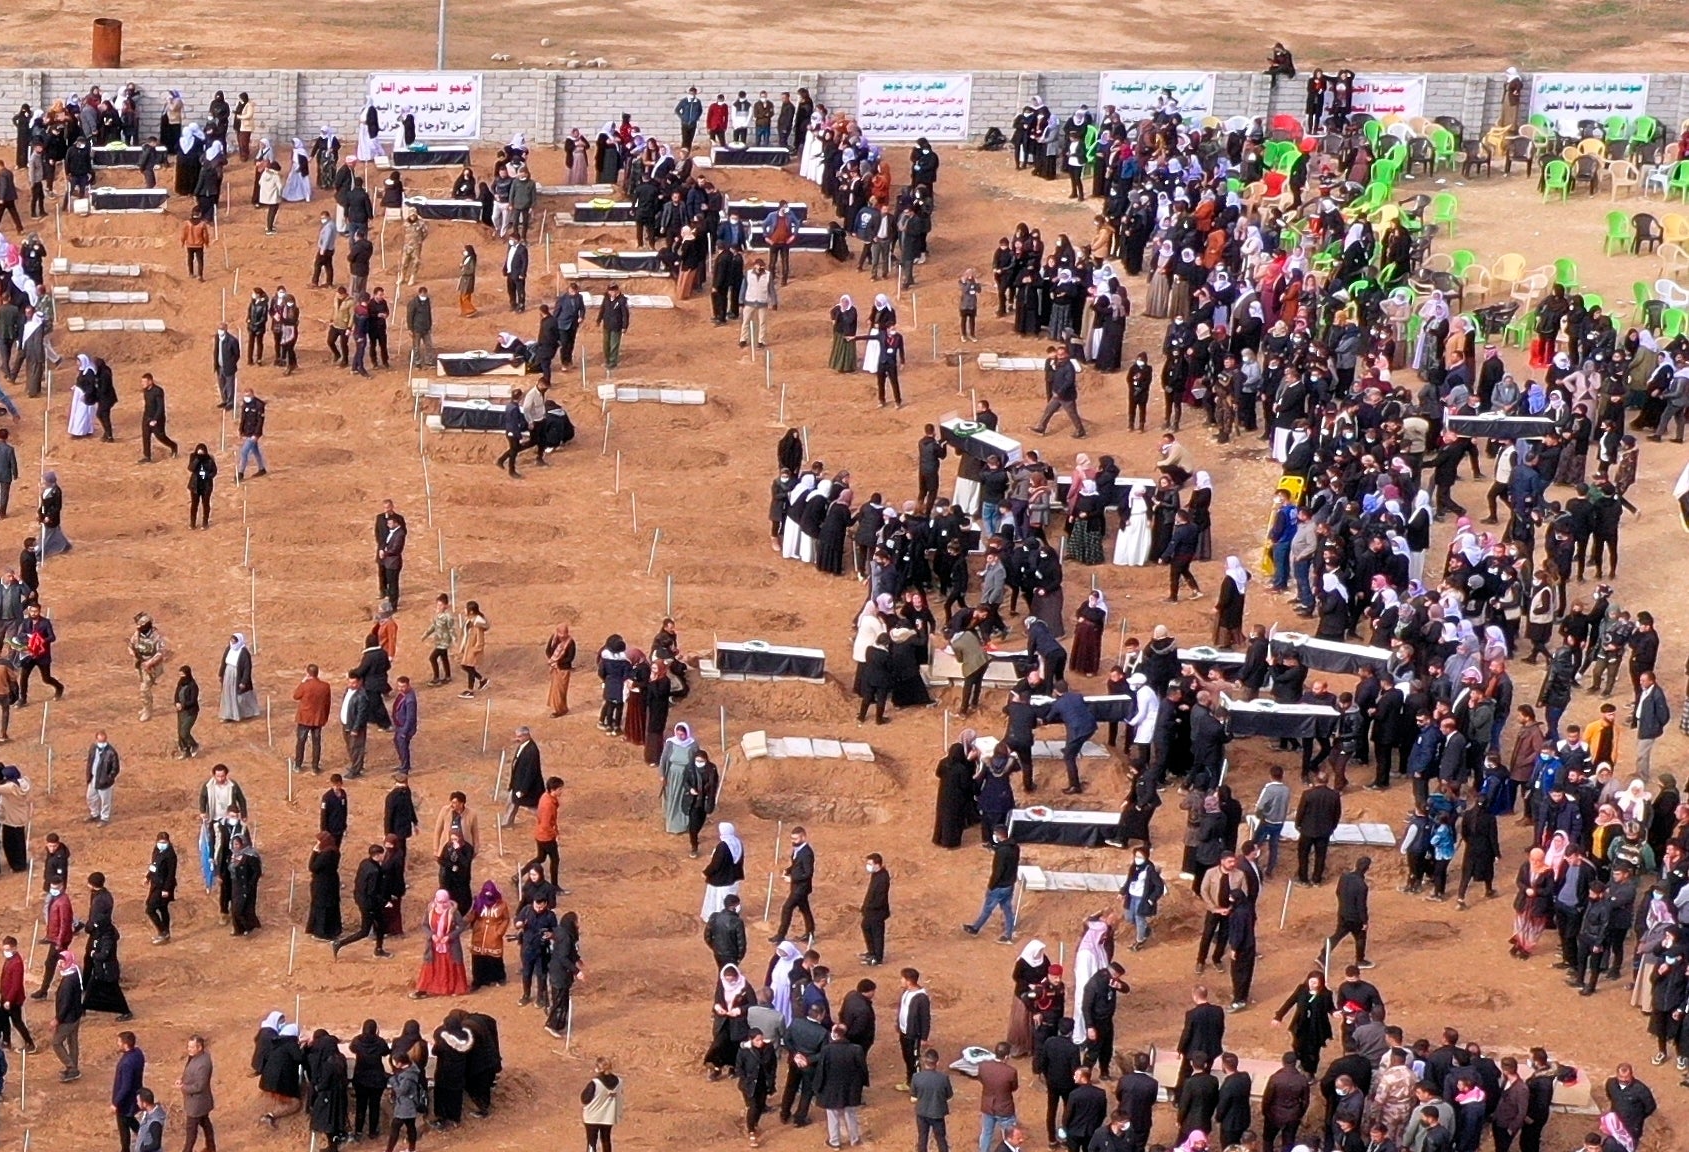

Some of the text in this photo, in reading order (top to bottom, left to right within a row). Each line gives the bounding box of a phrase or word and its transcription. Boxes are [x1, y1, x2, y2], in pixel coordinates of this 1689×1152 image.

[375, 82, 395, 94] النار
[397, 85, 410, 94] من
[448, 82, 472, 95] كوجو
[1111, 81, 1146, 93] الشهيدة
[1537, 83, 1562, 93] العراق
[451, 123, 465, 132] من
